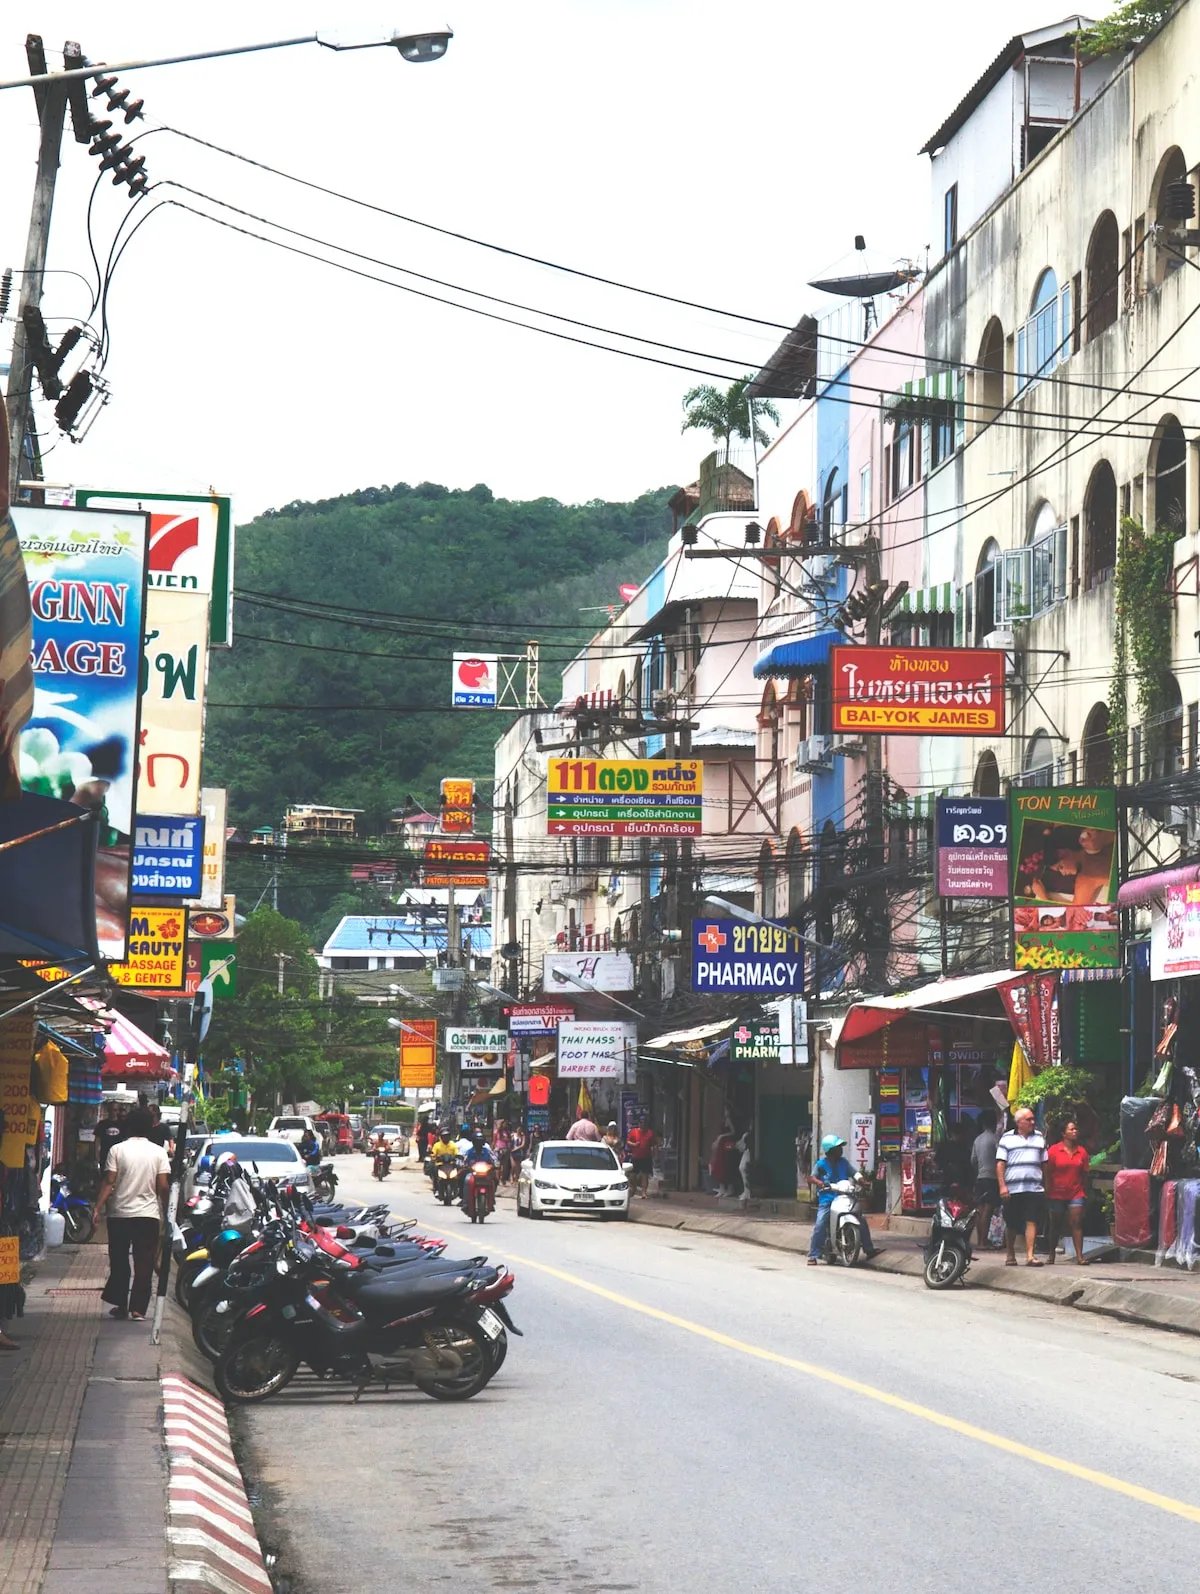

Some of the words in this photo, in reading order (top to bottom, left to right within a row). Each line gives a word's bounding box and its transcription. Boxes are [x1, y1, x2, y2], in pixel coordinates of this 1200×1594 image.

[30, 580, 128, 627] GINN
[889, 654, 950, 673] ห้างทอง
[846, 709, 921, 724] BAI-YOK
[928, 711, 990, 725] JAMES
[555, 761, 597, 791] 111
[1017, 795, 1052, 811] TON
[1057, 794, 1098, 811] PHAI
[133, 854, 196, 868] ปกรณ์
[129, 941, 183, 957] EAUTY
[135, 973, 172, 984] GENTS
[697, 961, 799, 986] PHARMACY
[561, 1036, 584, 1045] THAI
[560, 1051, 589, 1060] FOOT
[735, 1046, 781, 1058] PHARM
[560, 1065, 597, 1074] BARBER
